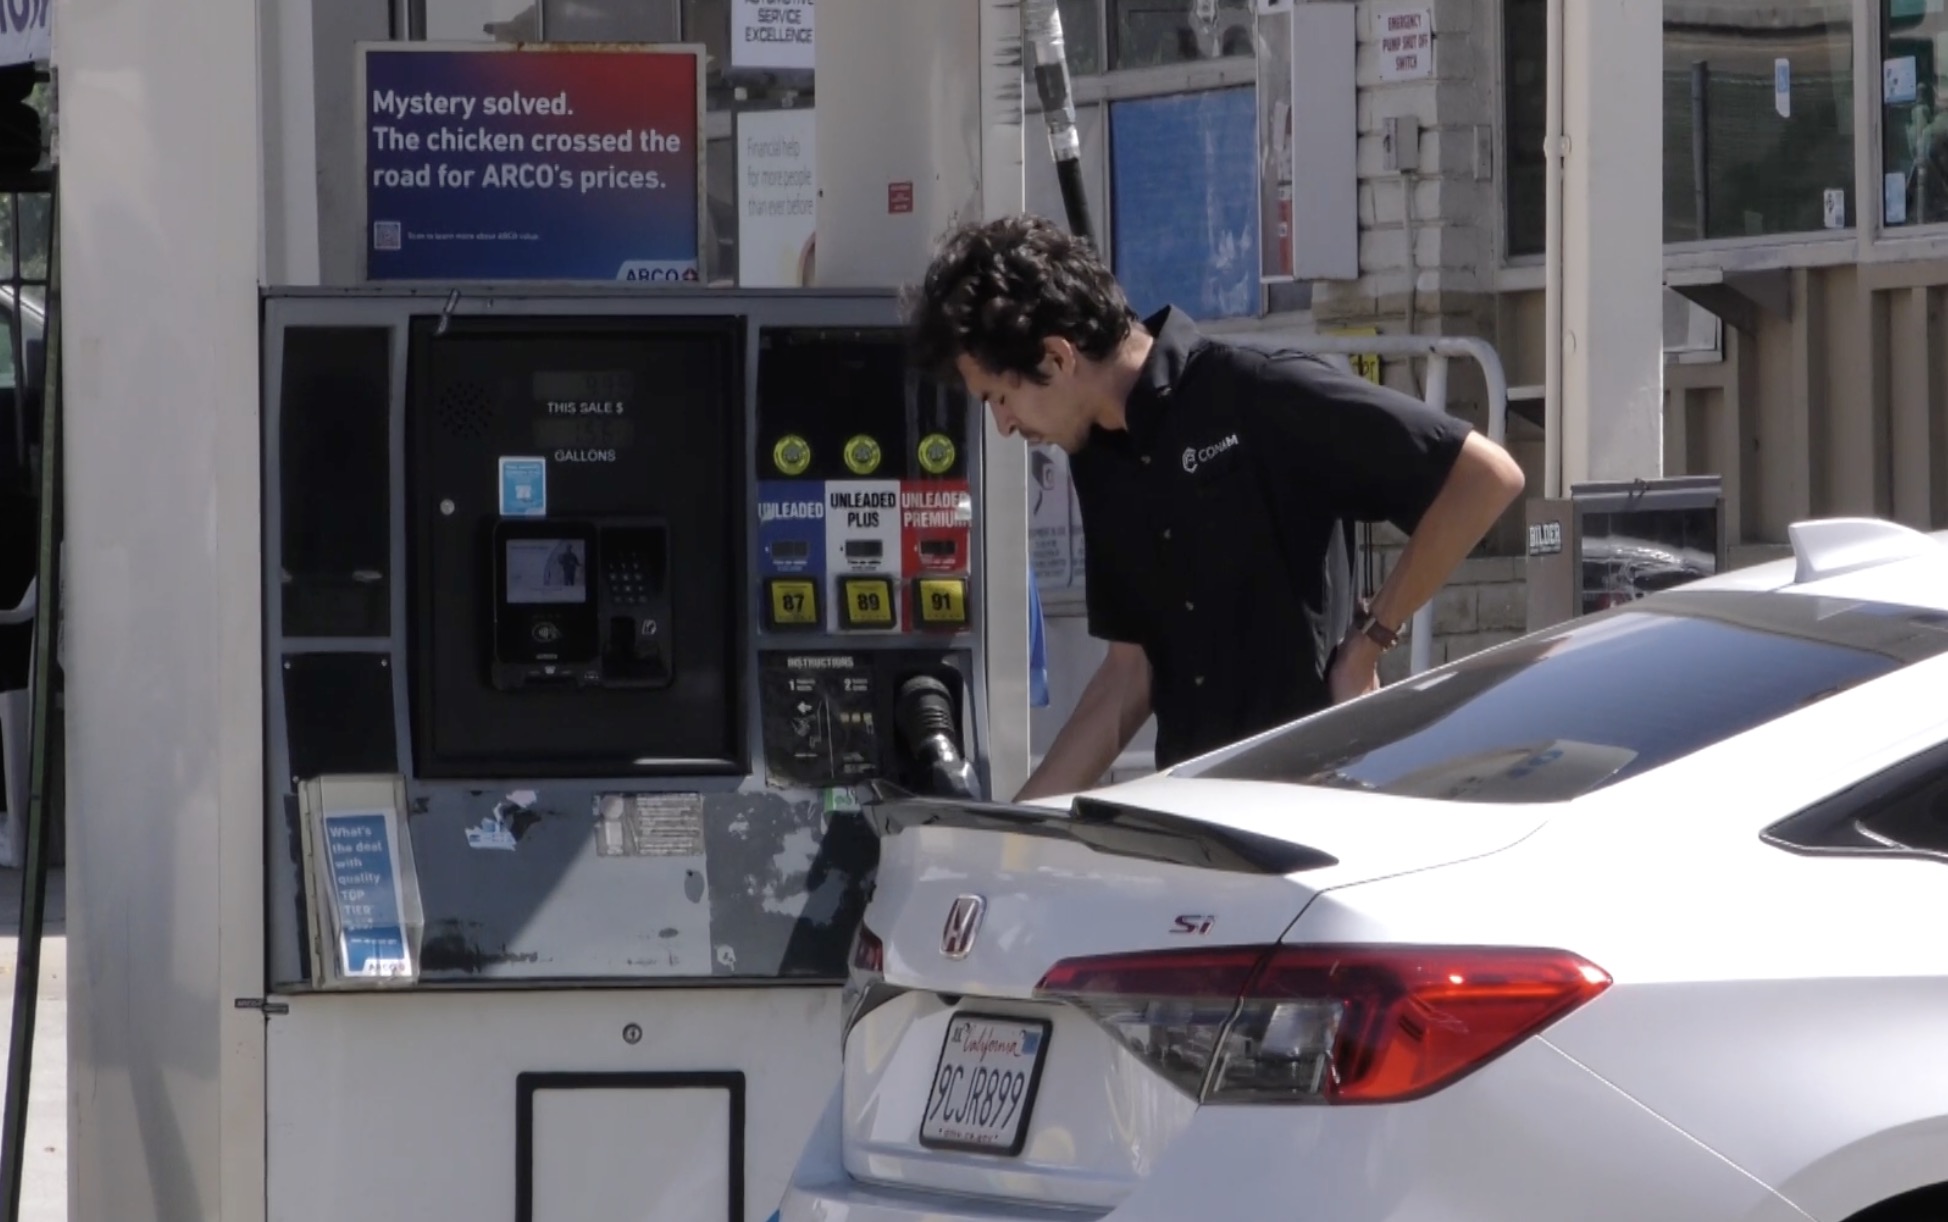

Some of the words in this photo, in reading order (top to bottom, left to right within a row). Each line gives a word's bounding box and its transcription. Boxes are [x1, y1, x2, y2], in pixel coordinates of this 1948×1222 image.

[758, 8, 802, 24] SERVICE
[1388, 14, 1421, 31] EMERGENCY
[745, 27, 813, 43] EXCELLENCE
[1383, 37, 1401, 52] PUMP
[1396, 54, 1417, 71] SWITCH
[373, 90, 476, 119] Mystery
[483, 91, 574, 116] solved.
[373, 127, 420, 151] The
[426, 127, 524, 152] chicken
[530, 130, 633, 153] crossed
[639, 130, 681, 153] the
[373, 164, 431, 188] road
[437, 164, 475, 188] for
[482, 164, 574, 189] ARCO's
[580, 165, 666, 193] prices.
[761, 170, 782, 186] more
[783, 165, 812, 189] people
[786, 193, 814, 216] before
[626, 268, 679, 281] ARCO
[547, 401, 577, 414] THIS
[580, 401, 612, 414] SALE
[615, 401, 624, 415] $
[554, 449, 616, 462] GALLONS
[1198, 433, 1239, 462] CONAM
[830, 493, 896, 508] UNLEADED
[758, 502, 824, 519] UNLEADED
[847, 512, 879, 528] PLUS
[1530, 523, 1561, 547] BILDER
[782, 594, 804, 613] 87
[857, 593, 880, 611] 89
[931, 593, 951, 611] 91
[787, 656, 854, 668] INSTRUCTIONS
[788, 679, 795, 691] 1
[844, 678, 852, 691] 2
[329, 826, 372, 838] What's
[333, 843, 352, 853] the
[356, 841, 382, 853] deal
[335, 859, 362, 869] with
[338, 872, 381, 886] quality
[341, 890, 365, 902] TOP
[1169, 914, 1215, 935] Si
[963, 1025, 1021, 1062] California
[930, 1063, 1025, 1130] 9CJR899
